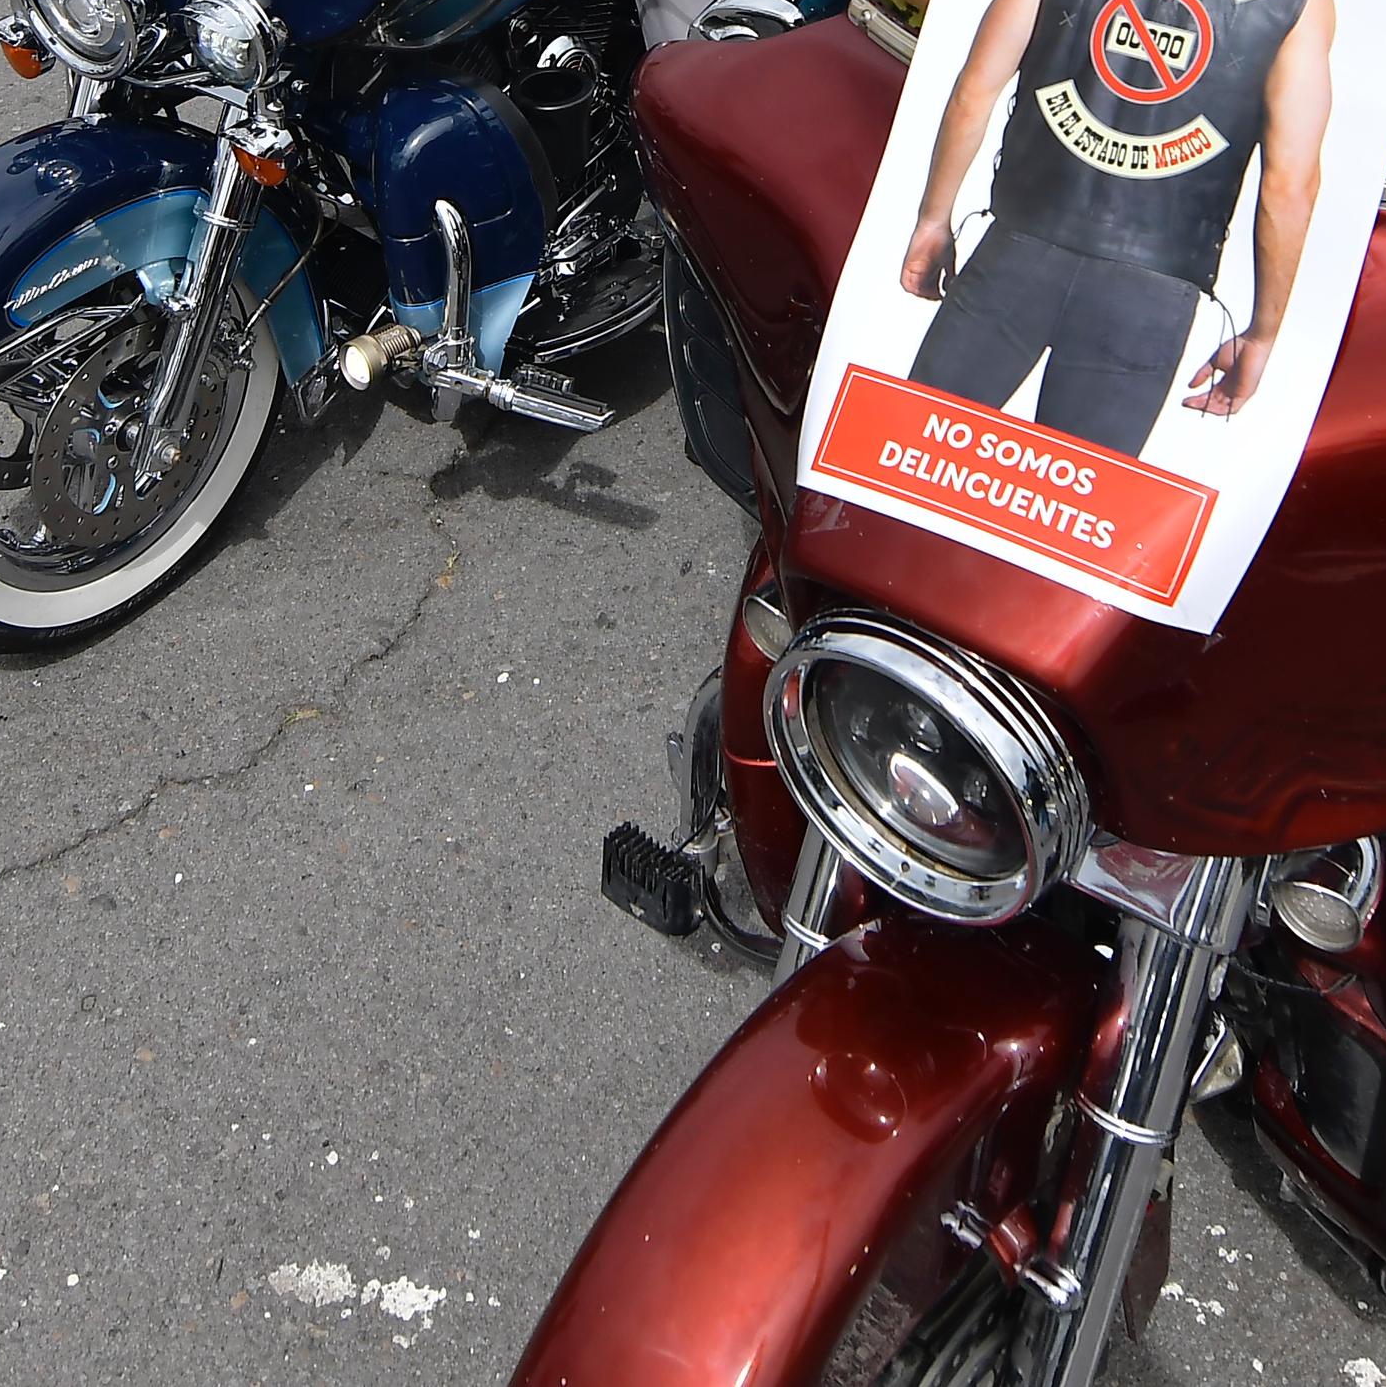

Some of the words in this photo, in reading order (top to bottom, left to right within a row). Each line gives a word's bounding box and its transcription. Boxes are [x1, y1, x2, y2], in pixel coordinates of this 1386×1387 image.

[1046, 90, 1073, 117] EN
[1057, 109, 1083, 138] EL
[1073, 125, 1128, 168] ESTADO
[1130, 145, 1149, 170] DE
[1152, 127, 1212, 170] MEXICO
[922, 412, 974, 450] NO
[975, 431, 1098, 496] SOMOS
[877, 439, 1117, 550] DELINCUENTES
